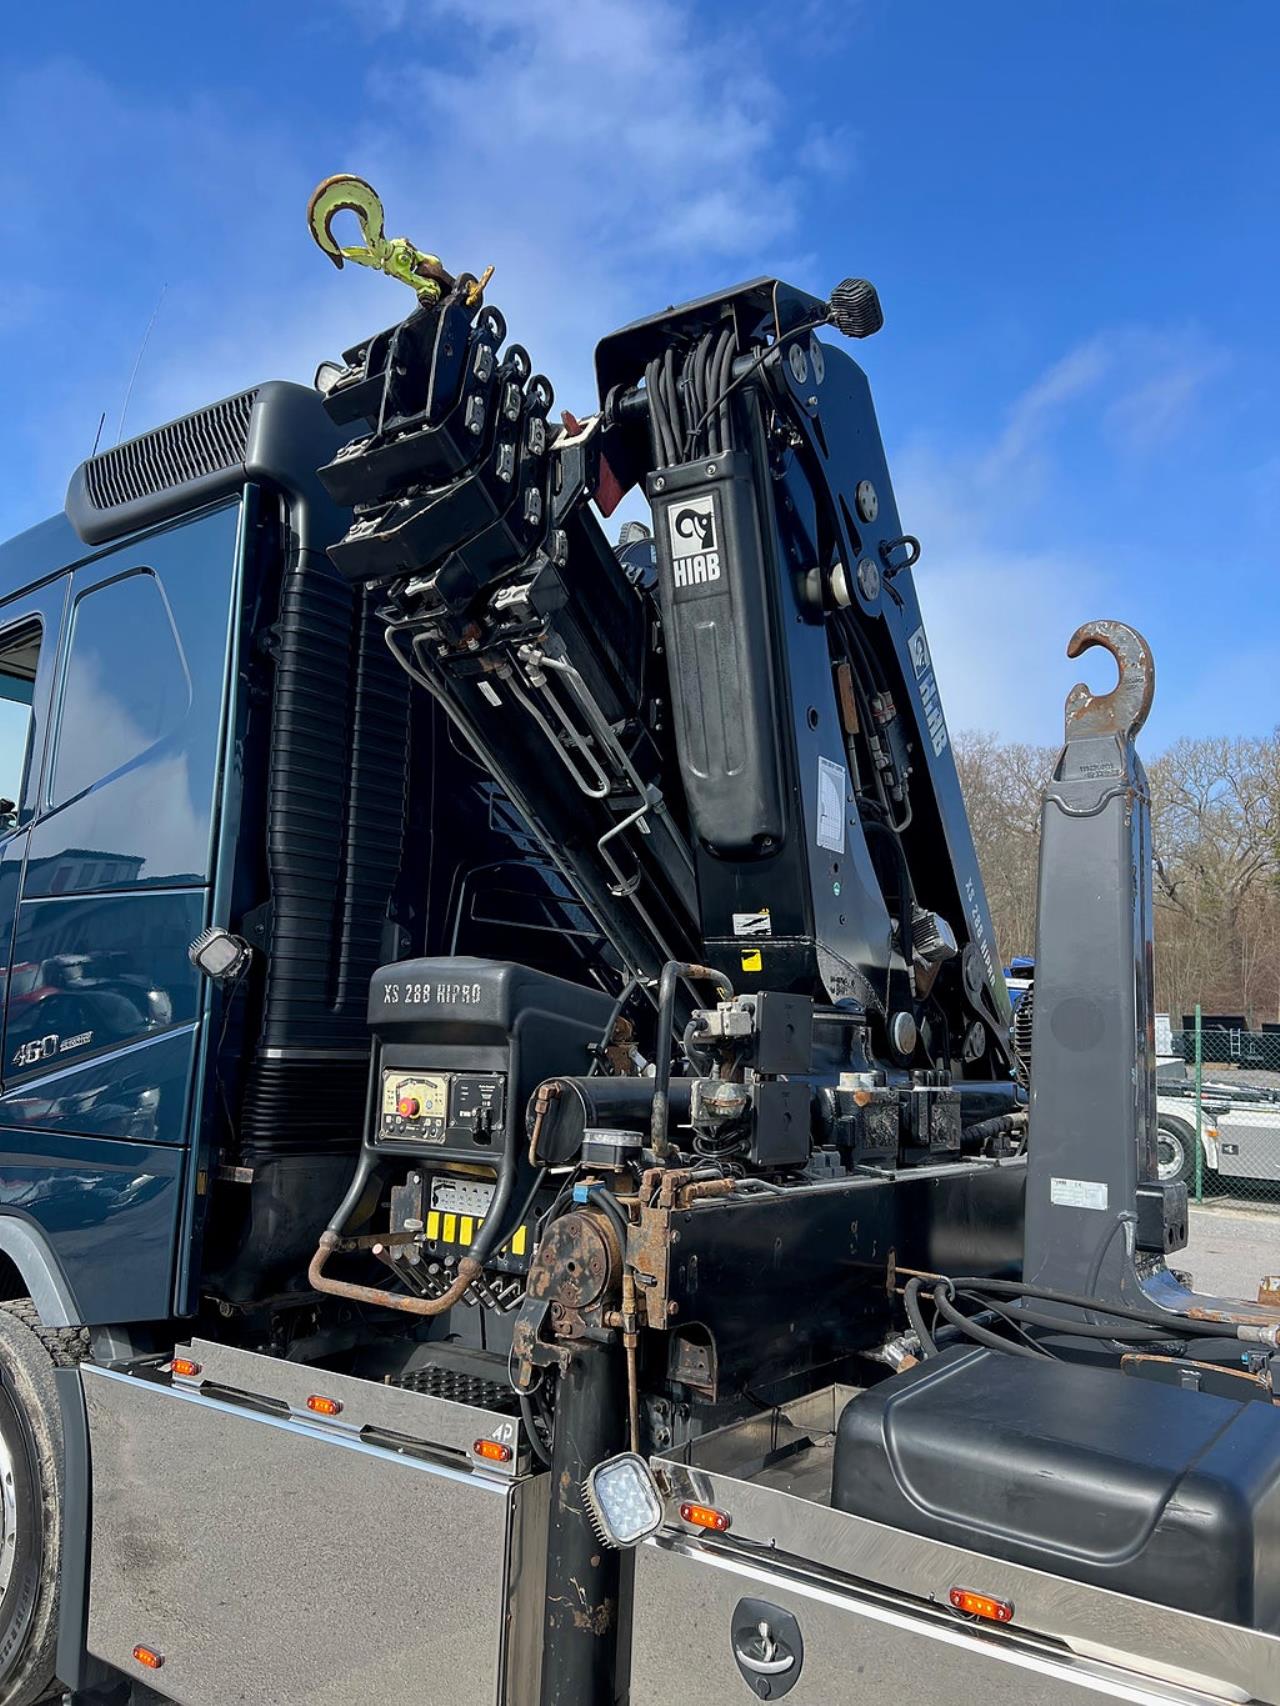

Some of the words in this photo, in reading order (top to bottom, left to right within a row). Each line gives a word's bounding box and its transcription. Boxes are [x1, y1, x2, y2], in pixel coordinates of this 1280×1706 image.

[673, 553, 720, 587] HIAB
[919, 672, 948, 757] HIAB
[965, 876, 975, 902] XS
[972, 904, 983, 938] 288
[384, 984, 399, 1003] XS
[405, 984, 430, 1003] 288
[437, 984, 480, 1003] HIPRO
[12, 1034, 59, 1066] 460
